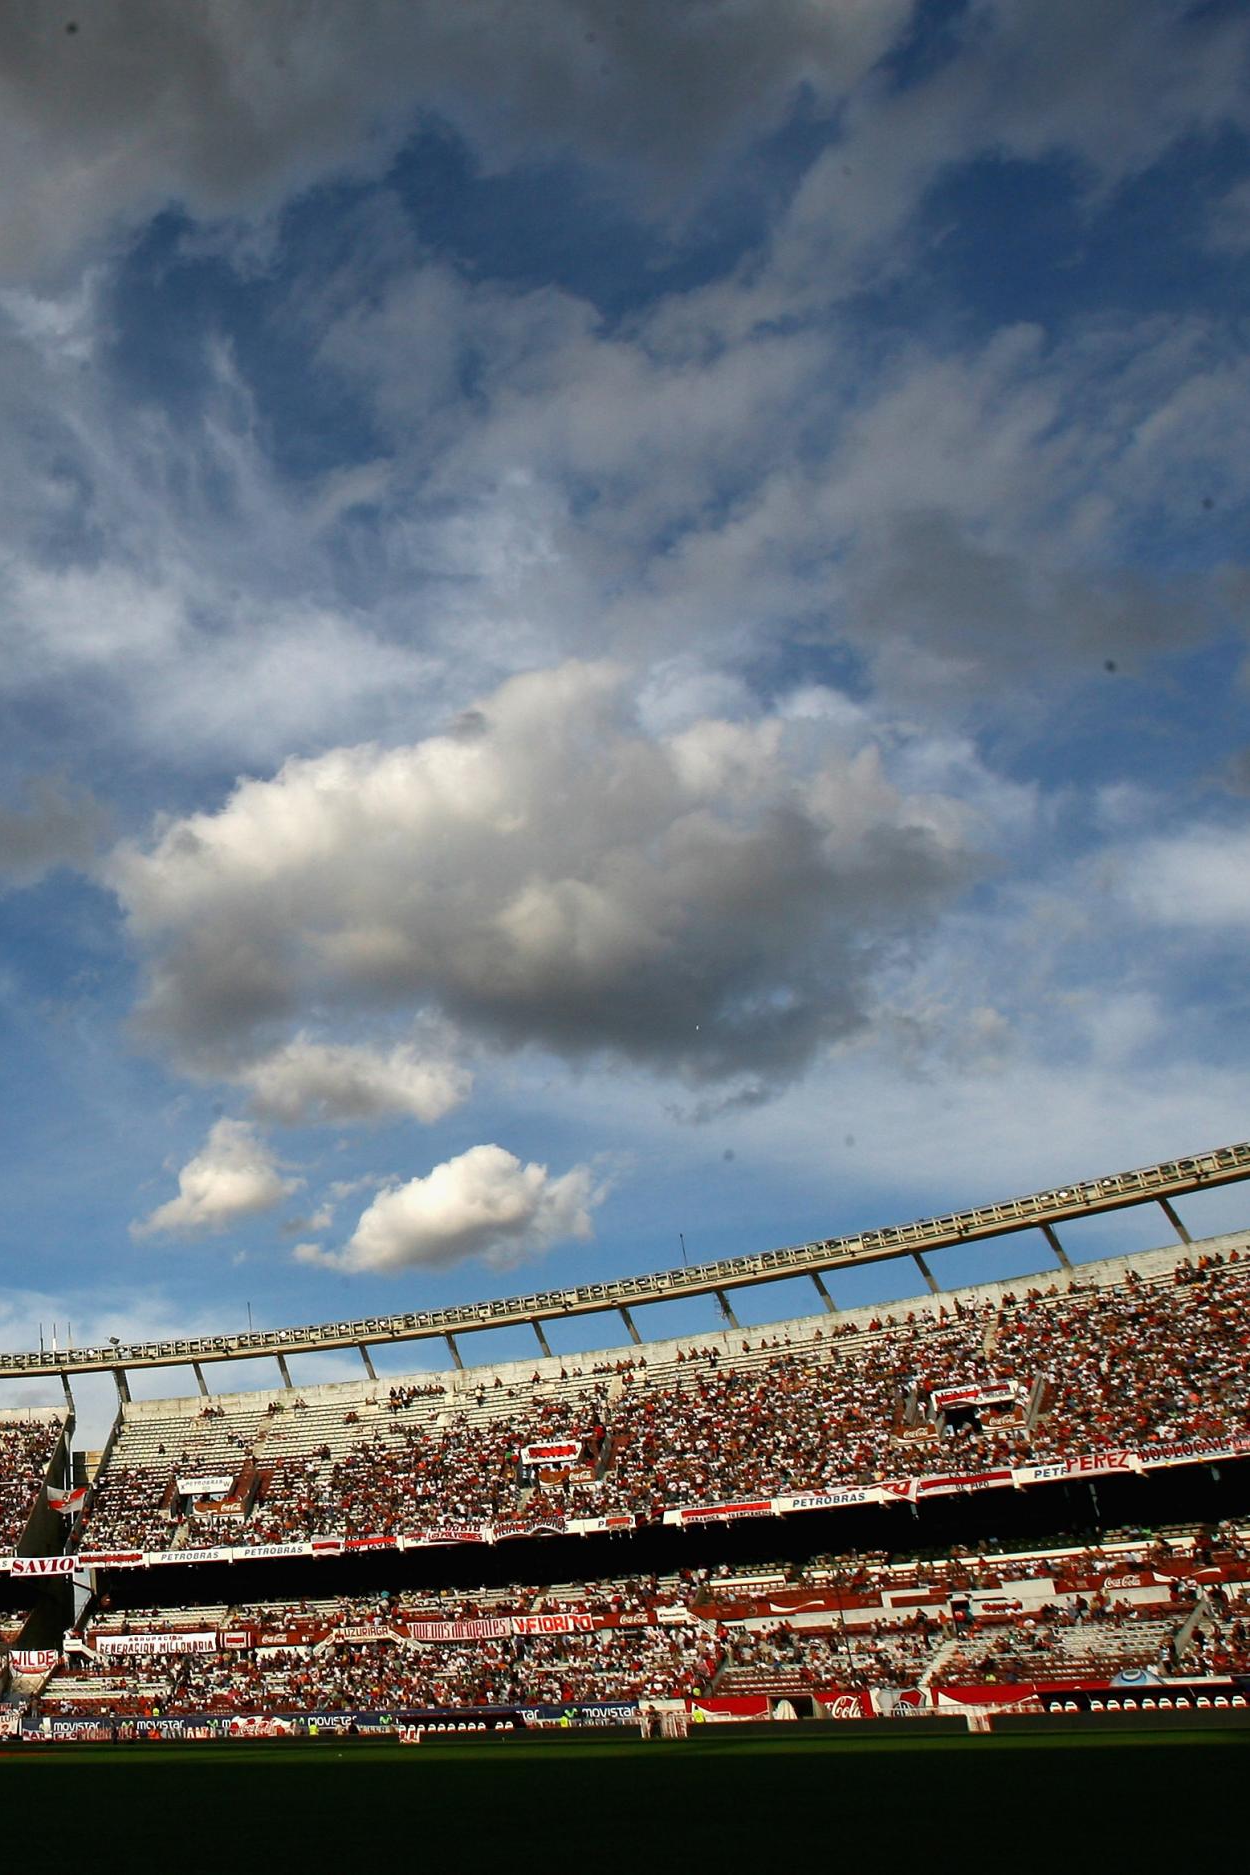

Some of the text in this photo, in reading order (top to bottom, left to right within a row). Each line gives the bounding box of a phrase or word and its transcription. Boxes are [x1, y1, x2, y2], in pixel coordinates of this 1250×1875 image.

[1066, 1449, 1131, 1472] PEREZ
[792, 1492, 866, 1508] PETROBRAS
[161, 1551, 219, 1562] PETROBRAS
[244, 1546, 303, 1557] PETROBRAS
[12, 1557, 74, 1574] SAVIO
[1104, 1574, 1141, 1589] Coca-Cola
[620, 1613, 648, 1625] Coca-Cola
[261, 1634, 287, 1644] Coca-Cola
[100, 1640, 214, 1655] GENERACION MILLONARIA
[582, 1706, 636, 1719] movistar
[53, 1721, 100, 1731] movistar
[136, 1719, 185, 1730] movistar
